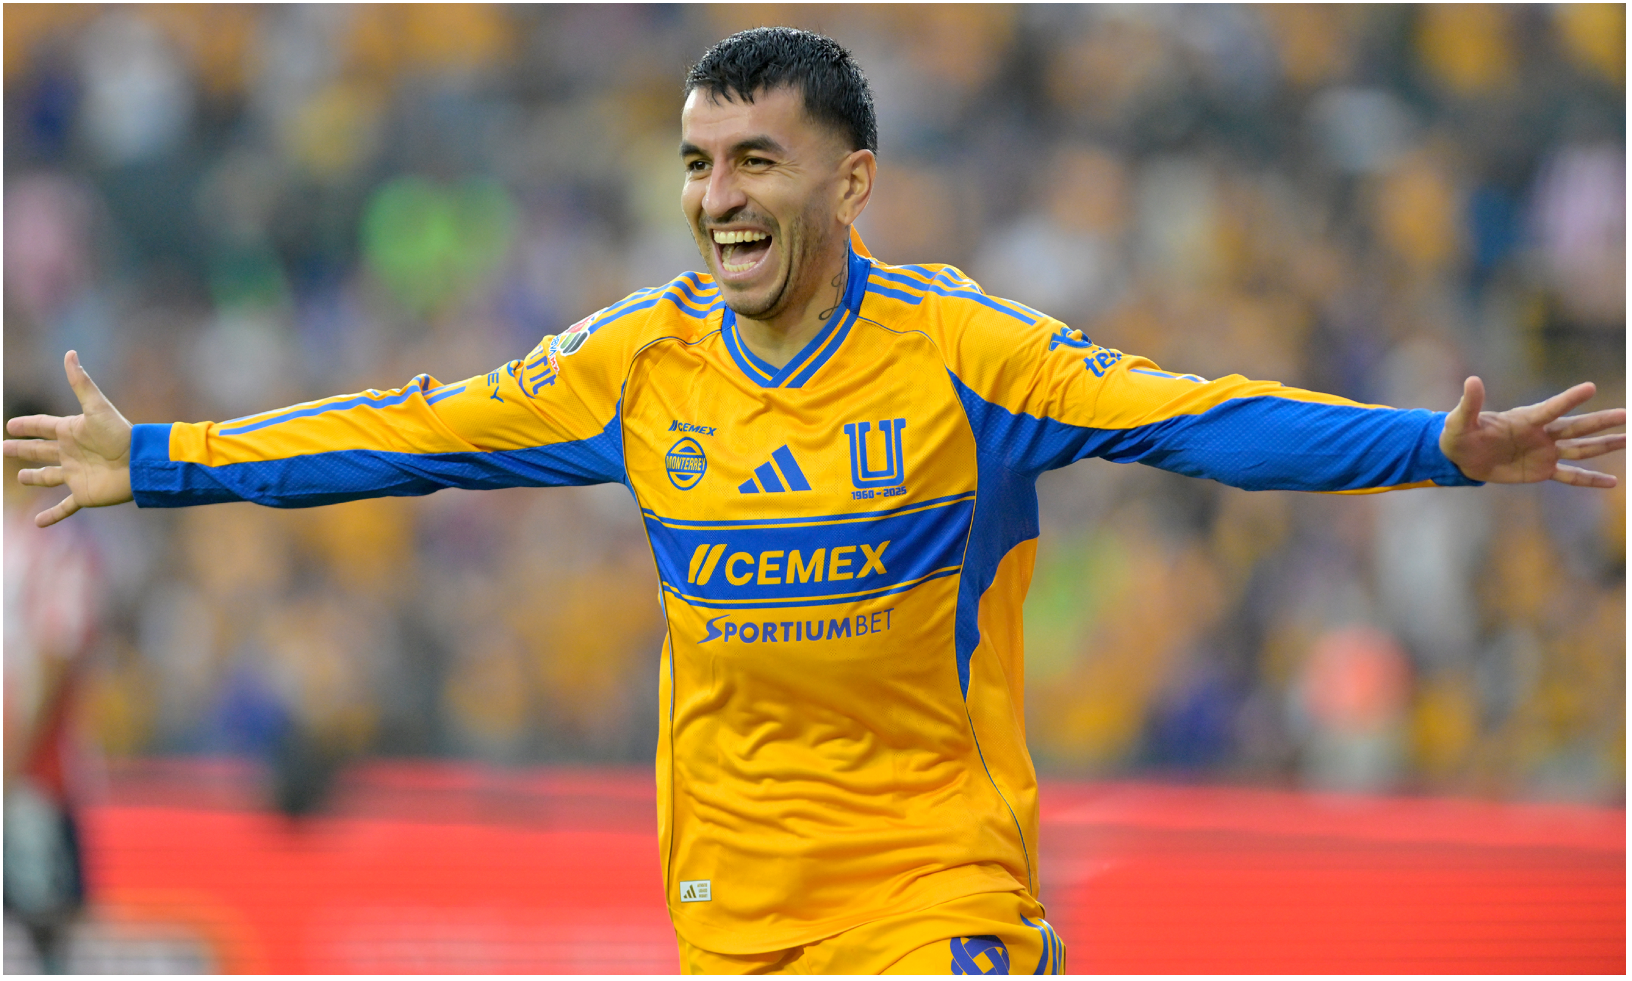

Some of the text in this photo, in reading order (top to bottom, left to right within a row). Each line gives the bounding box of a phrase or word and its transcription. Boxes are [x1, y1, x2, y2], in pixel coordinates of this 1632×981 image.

[678, 422, 717, 436] CEMEX
[666, 456, 706, 470] MONTERREY
[725, 540, 891, 586] CEMEX
